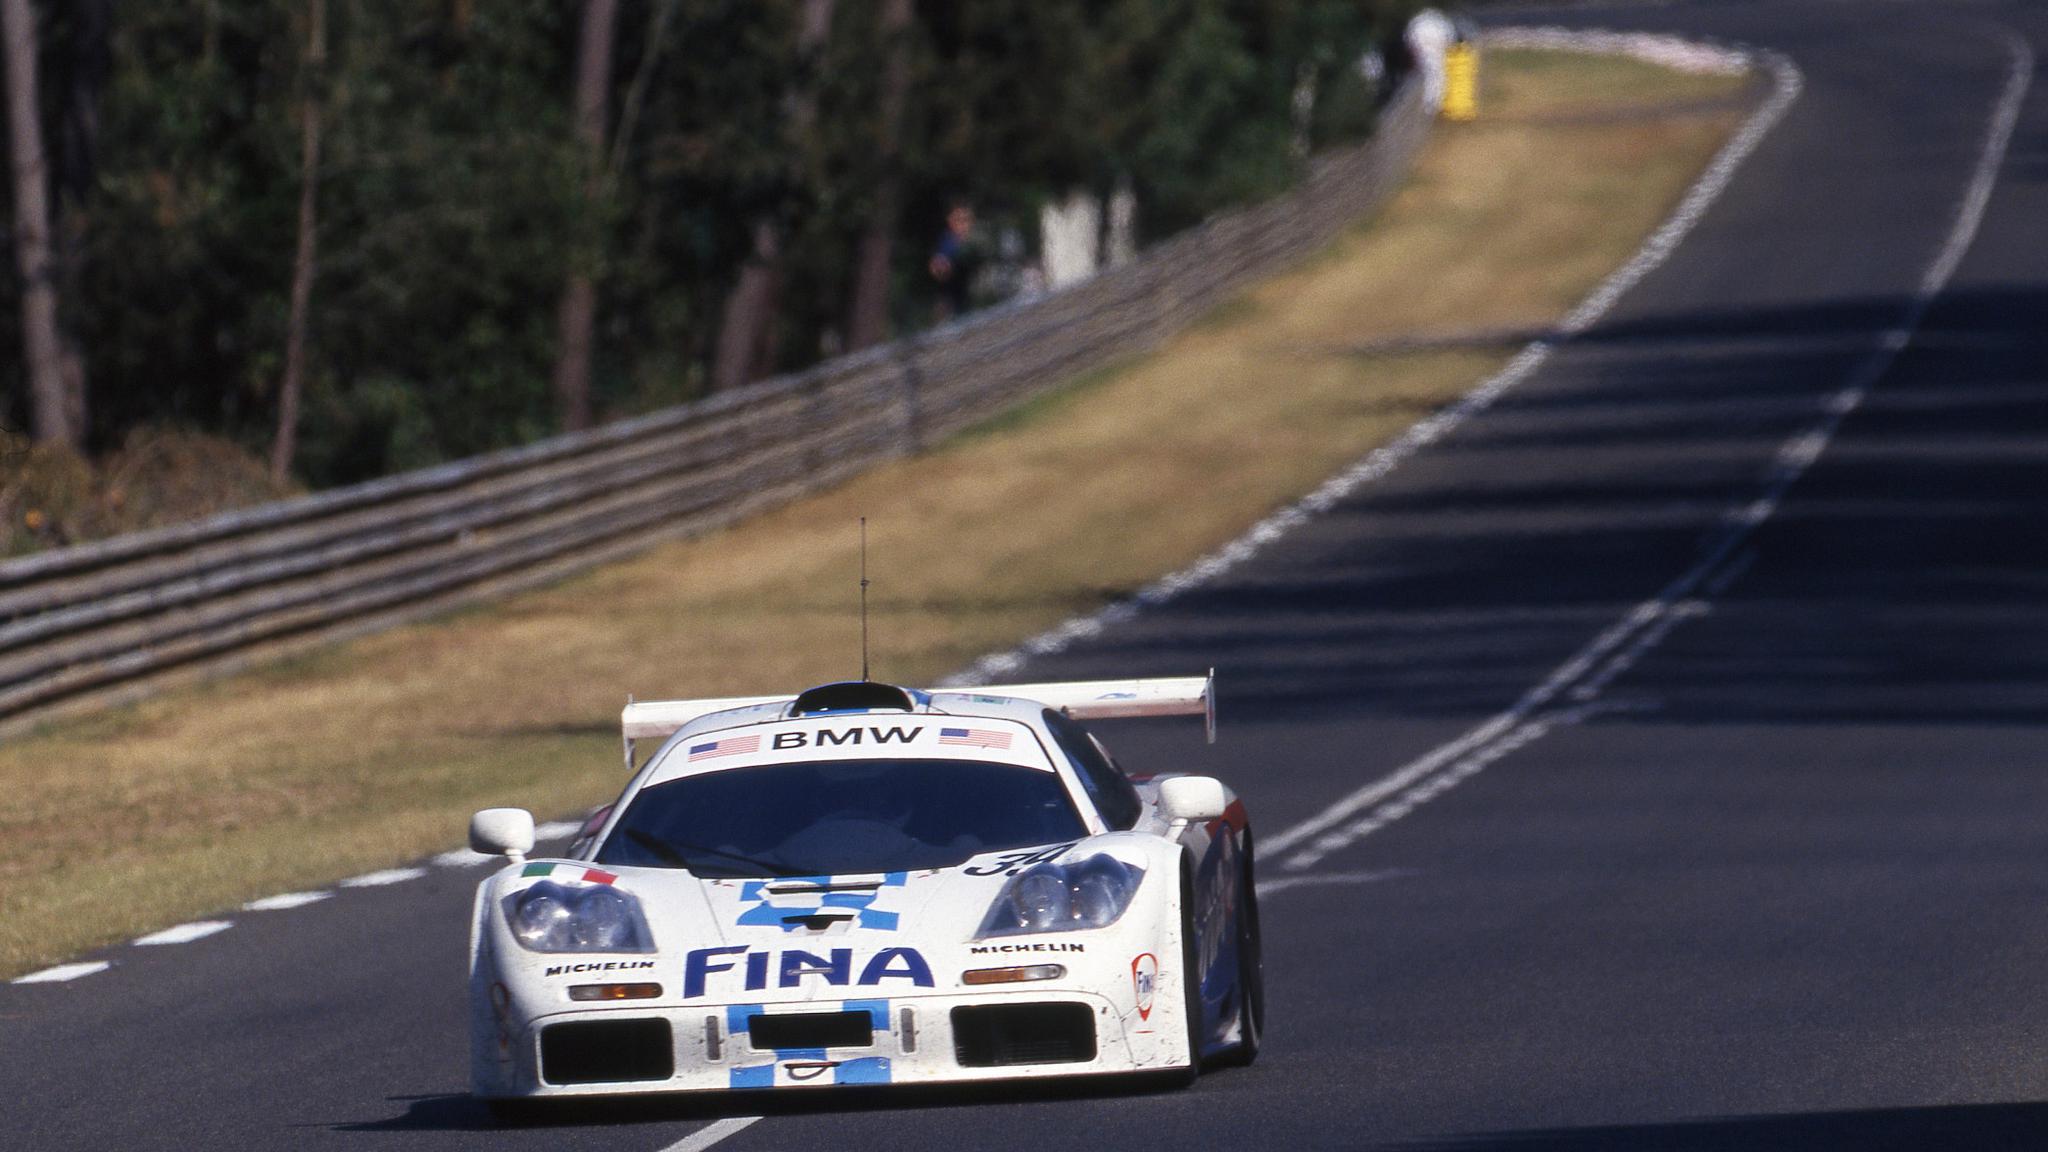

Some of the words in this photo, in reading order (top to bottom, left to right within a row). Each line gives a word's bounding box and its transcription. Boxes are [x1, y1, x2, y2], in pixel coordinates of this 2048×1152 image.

[773, 726, 923, 750] BMW
[971, 943, 1084, 954] MICHELIN
[545, 961, 655, 977] MICHELIN
[683, 944, 936, 999] FINA
